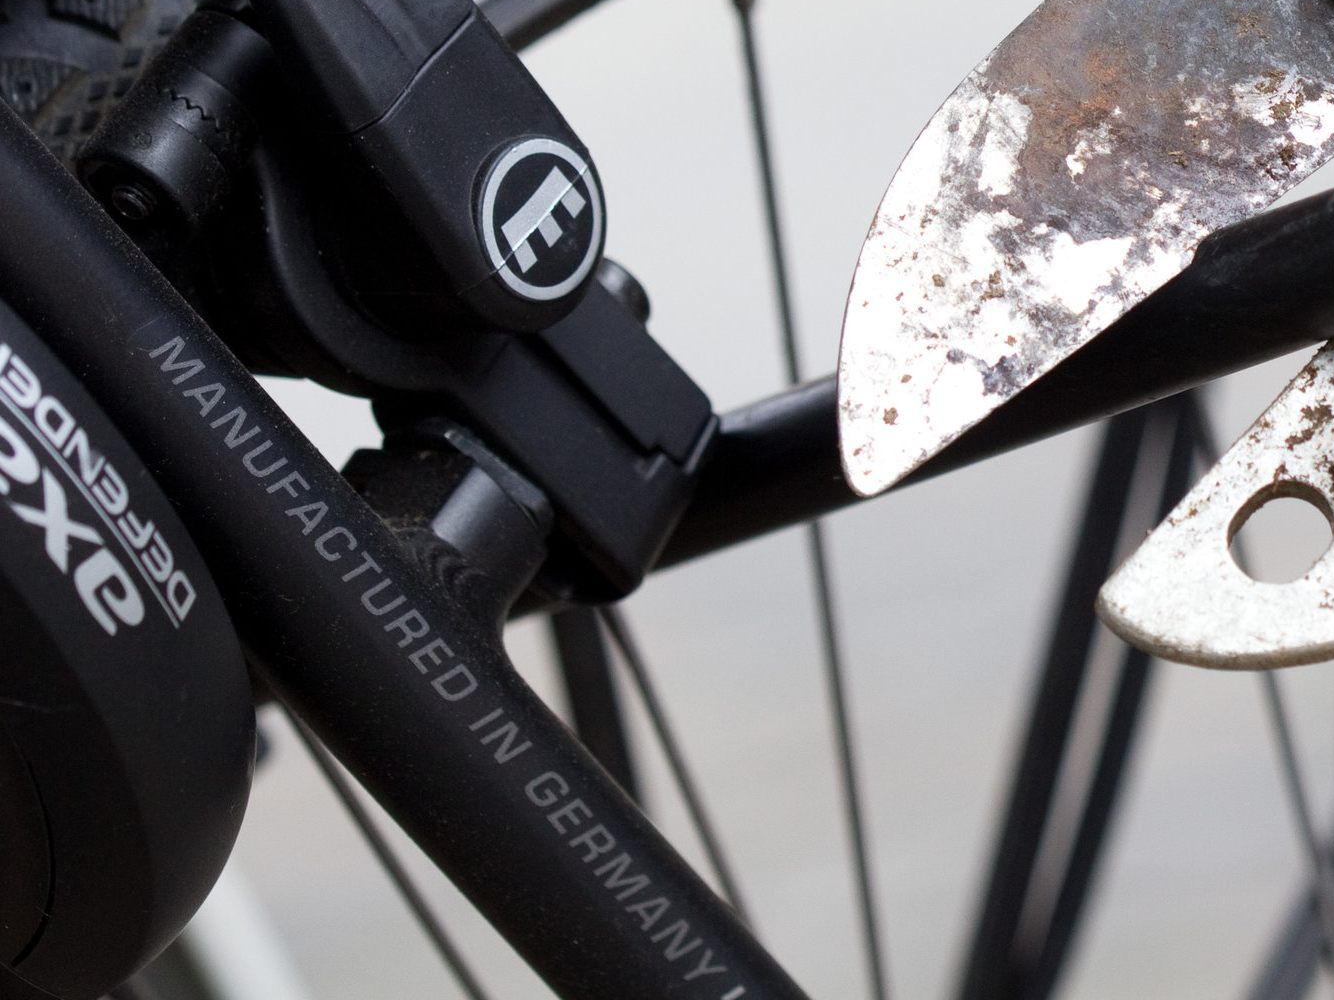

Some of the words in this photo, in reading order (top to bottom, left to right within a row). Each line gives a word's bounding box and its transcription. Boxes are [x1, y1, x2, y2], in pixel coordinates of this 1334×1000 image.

[0, 342, 197, 623] DEFENDE
[148, 335, 479, 702] MANUFACTURED
[468, 707, 534, 765] IN
[523, 770, 728, 981] GERMANY
